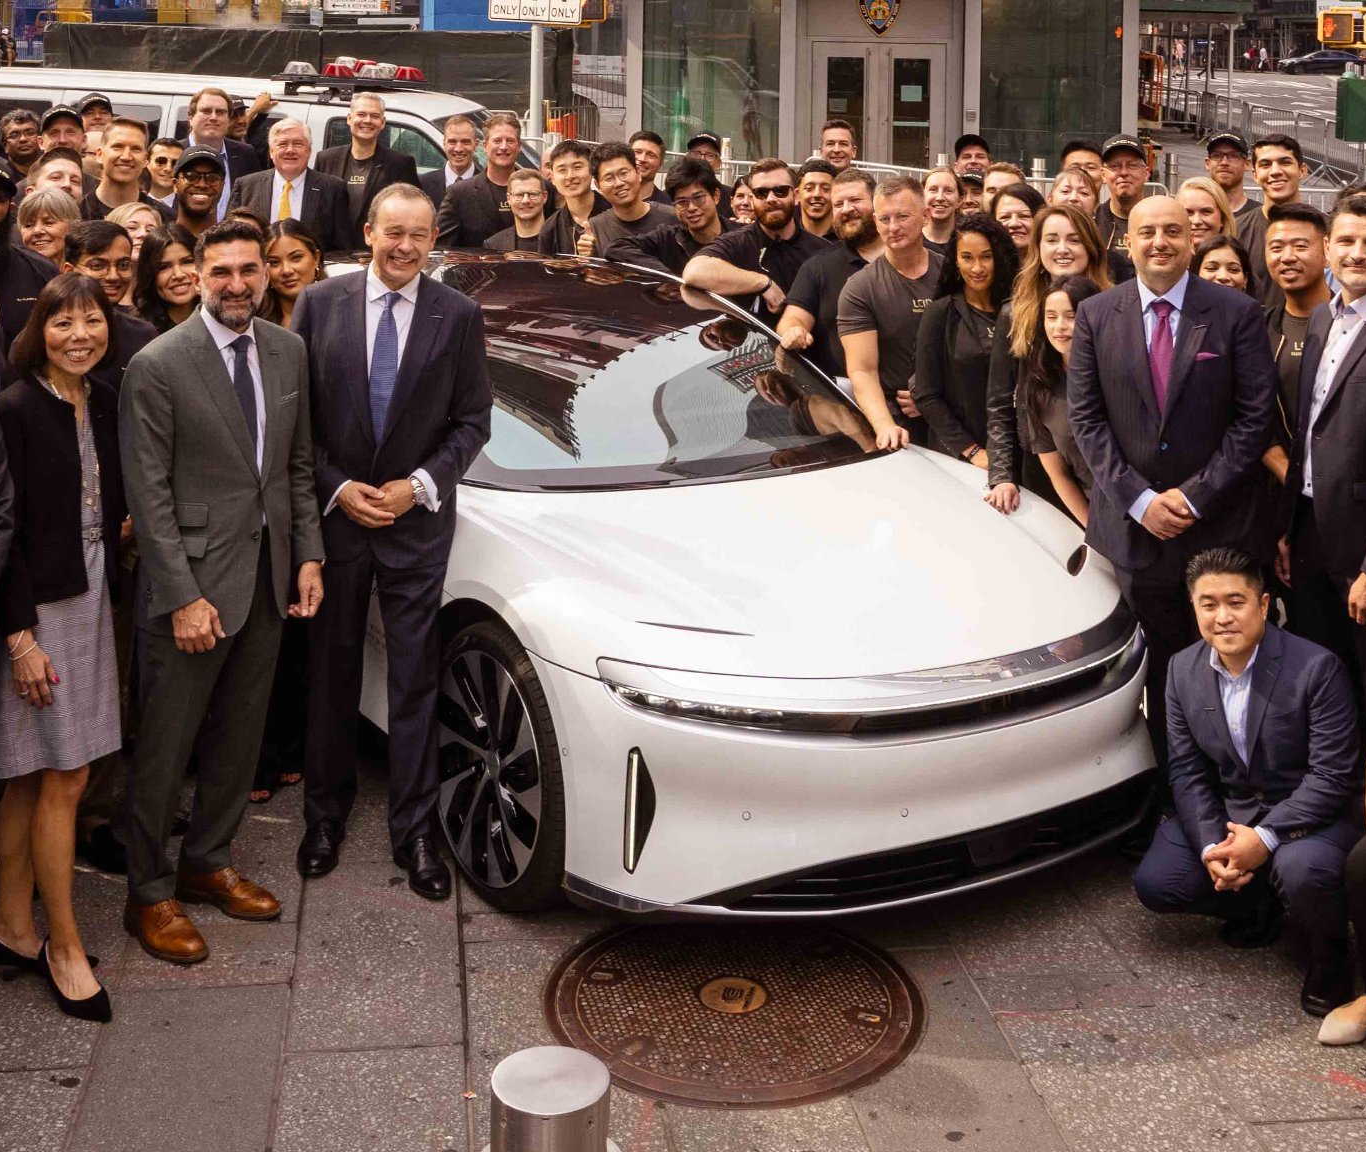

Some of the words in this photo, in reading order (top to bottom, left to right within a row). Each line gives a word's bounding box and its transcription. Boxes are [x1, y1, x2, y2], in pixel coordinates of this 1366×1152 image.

[494, 5, 518, 15] ONLY
[522, 6, 546, 17] ONLY
[551, 8, 576, 18] ONLY
